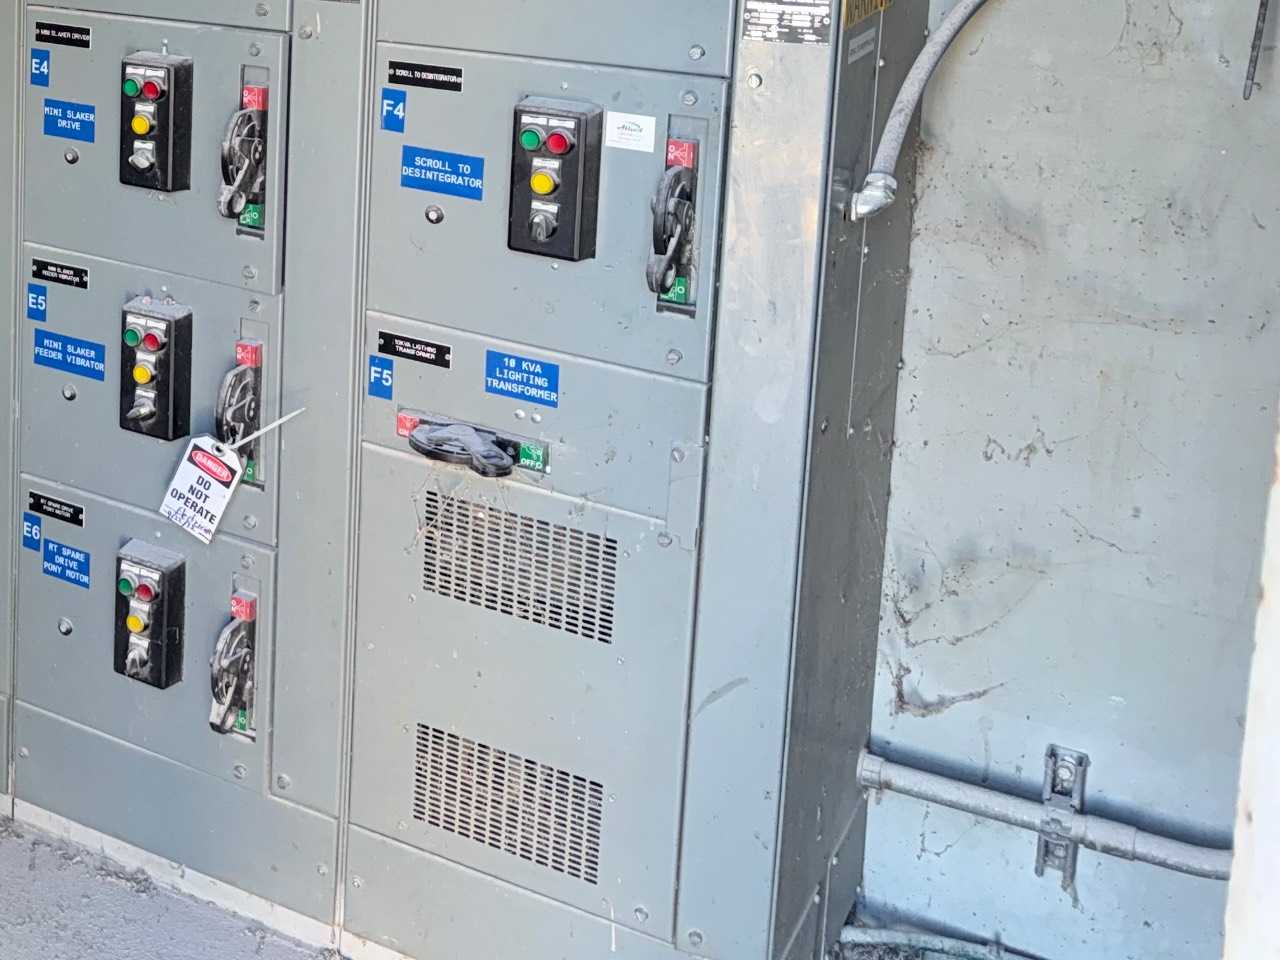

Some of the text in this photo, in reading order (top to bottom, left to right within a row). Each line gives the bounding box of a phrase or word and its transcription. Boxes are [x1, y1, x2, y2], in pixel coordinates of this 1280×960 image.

[31, 58, 48, 75] E4
[395, 69, 421, 80] SCROLL TO
[44, 106, 95, 122] MINI SLAKER
[384, 100, 405, 119] F4
[57, 119, 81, 131] DRIVE
[415, 156, 471, 174] SCROLL TO
[402, 166, 482, 189] DESINTEGRATOR
[56, 267, 74, 275] SLAKER
[58, 273, 80, 282] VIBRATOR
[28, 294, 46, 310] E5
[44, 339, 95, 358] MINI SLAKER
[396, 345, 436, 360] TRANSFORMER
[35, 347, 105, 372] FEEDER VIBRATOR
[504, 358, 542, 374] 10 KVA
[370, 366, 393, 386] F5
[496, 368, 549, 388] LIGHTING
[486, 378, 557, 402] TRANSFORMER
[195, 453, 229, 479] DANGER
[196, 475, 212, 491] DO
[187, 485, 210, 504] NOT
[170, 488, 217, 525] OPERATE
[24, 523, 40, 539] E6
[48, 543, 85, 562] RT SPARE
[55, 555, 78, 569] DRIVE
[44, 562, 89, 584] PONY MOTOR
